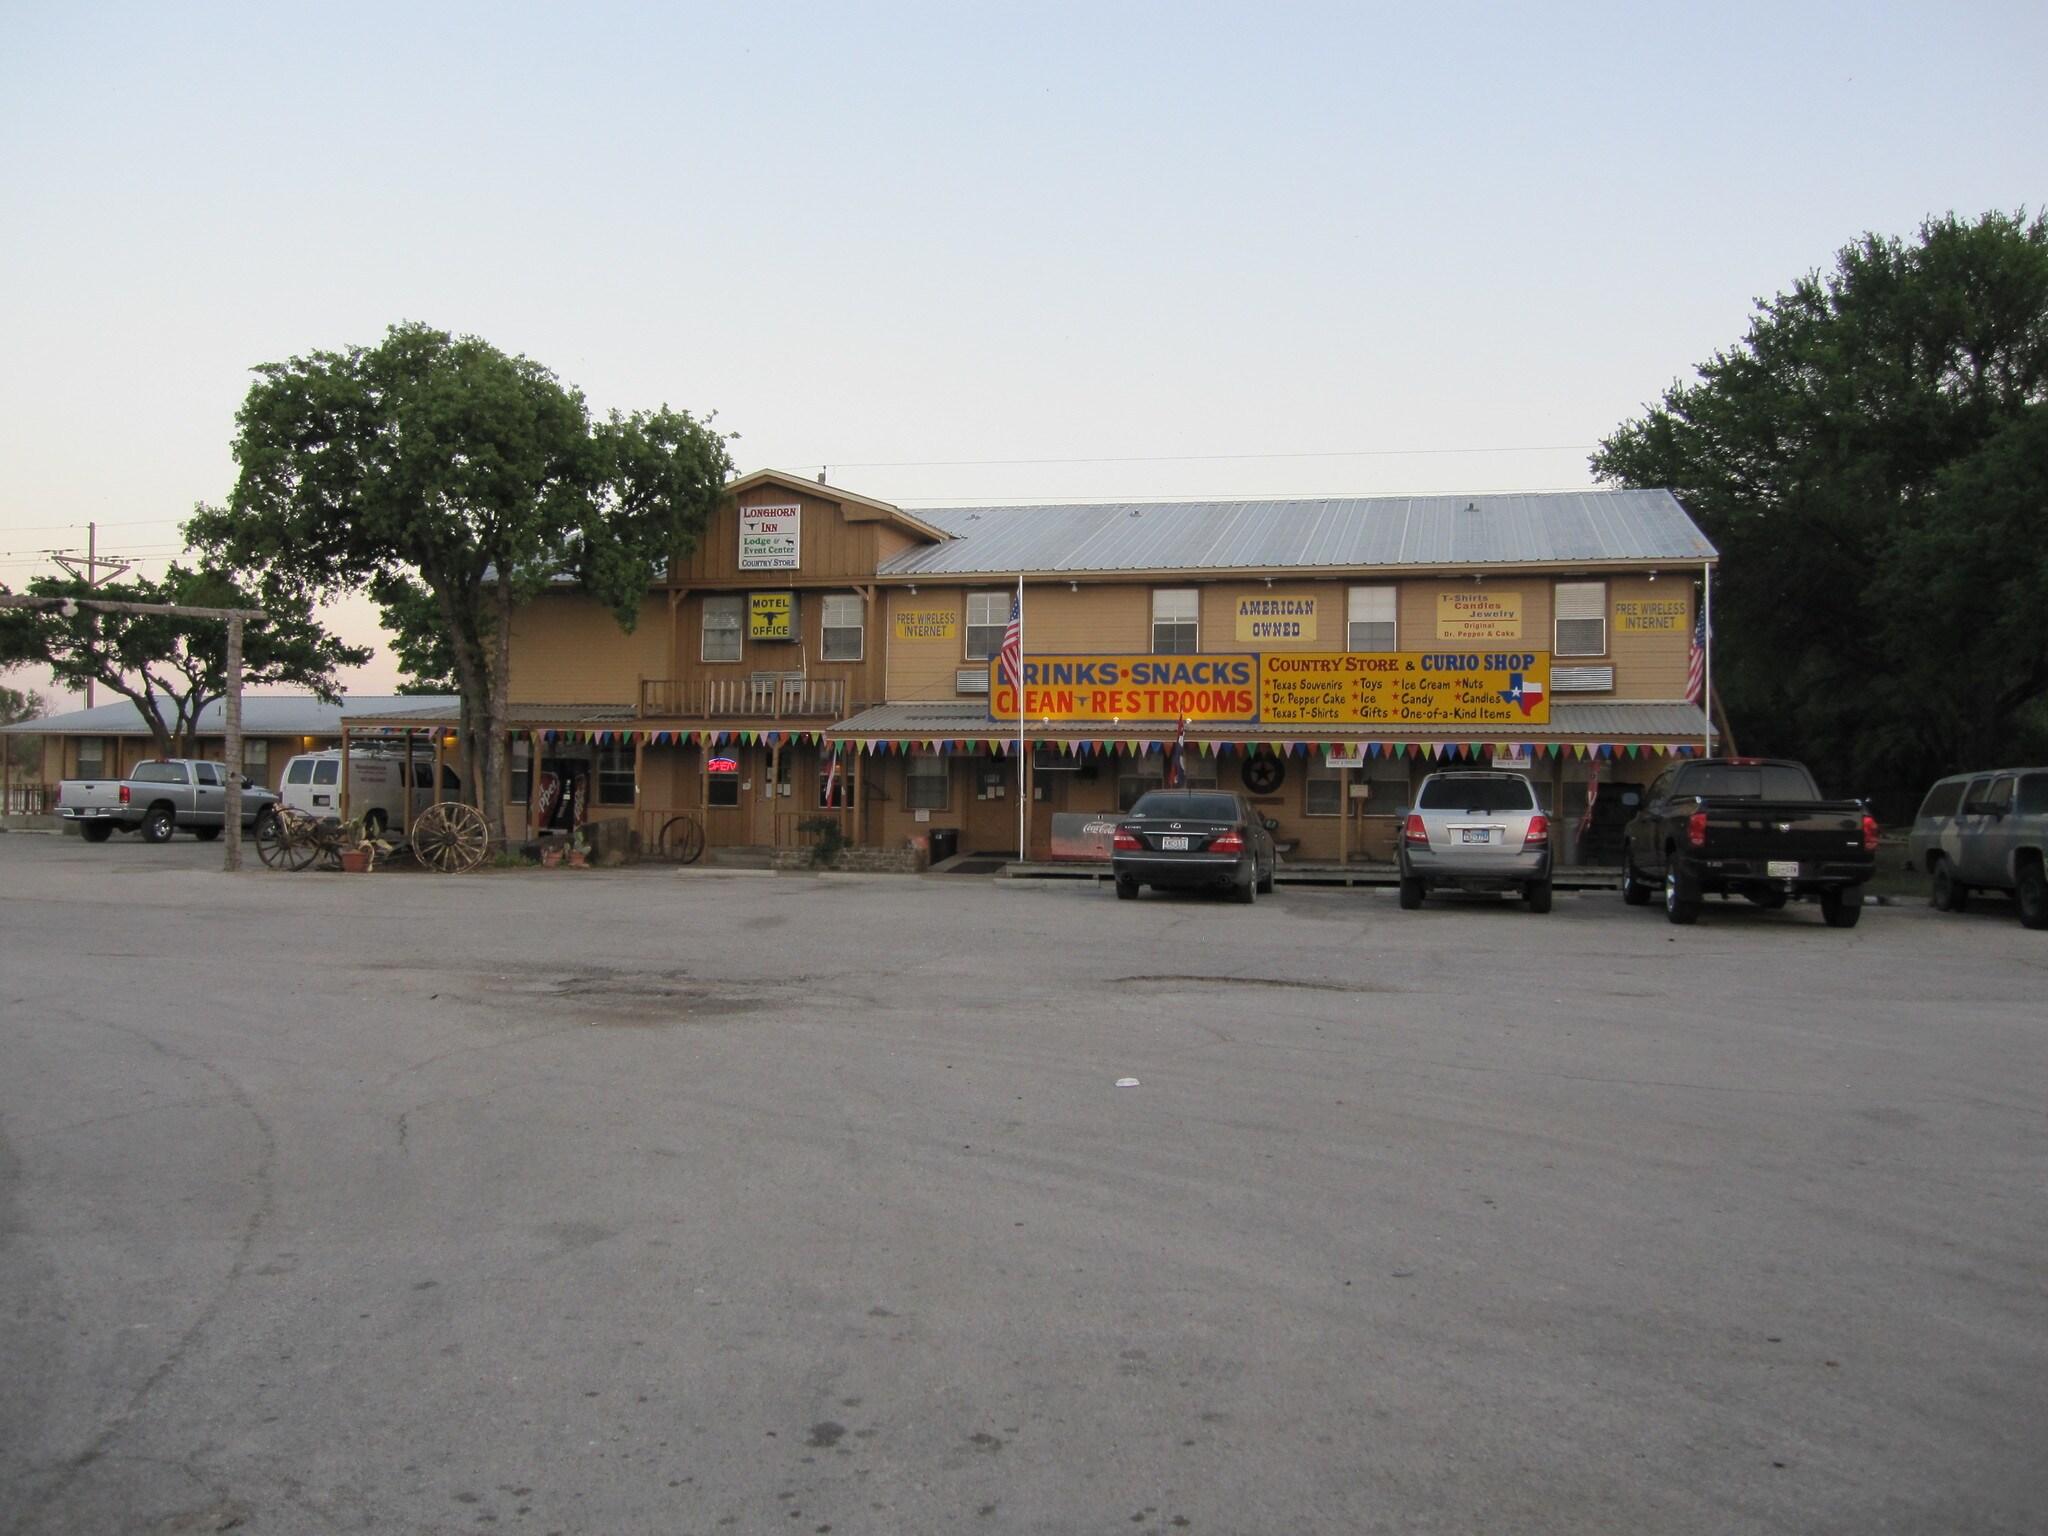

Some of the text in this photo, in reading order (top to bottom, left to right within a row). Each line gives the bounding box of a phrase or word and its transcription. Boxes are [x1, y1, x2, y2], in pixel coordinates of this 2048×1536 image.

[744, 508, 796, 518] LONGHORN
[761, 522, 778, 533] INN
[744, 537, 771, 546] Lodge
[744, 546, 795, 555] Event Center
[742, 558, 795, 567] COUNTRY STORE
[752, 599, 789, 608] MOTEL
[1442, 594, 1488, 602] T-Shirts
[1239, 601, 1314, 615] AMERICAN
[1454, 602, 1501, 610] Candles
[1616, 602, 1686, 615] FREE WIRELESS
[896, 612, 955, 624] FREE WIRELESS
[1469, 610, 1515, 618] Jewelry
[1625, 616, 1676, 629] INTERNET
[752, 626, 788, 636] OFFICE
[904, 625, 947, 637] INTERNET
[1253, 622, 1300, 637] OWNED
[1268, 653, 1535, 672] COUNTRY STORE & CURIO SHOP
[1131, 662, 1251, 686] SNACKS
[1272, 678, 1343, 690] Texas Souvenirs
[1360, 677, 1382, 692] Toys
[1401, 678, 1450, 690] Ice Cream
[1462, 677, 1484, 689] Nuts
[1092, 690, 1253, 713] RESTROOMS
[1272, 692, 1346, 706] Dr. Pepper Cake
[1360, 692, 1377, 704] Ice
[1401, 692, 1433, 706] Candy
[1462, 691, 1501, 704] Candles
[1272, 707, 1339, 718] Texas T-Shirts
[1360, 705, 1388, 718] Gifts
[1401, 707, 1511, 719] One-of-a-Kind Items
[708, 760, 737, 771] OPEN
[1083, 823, 1116, 834] Coca-Cola
